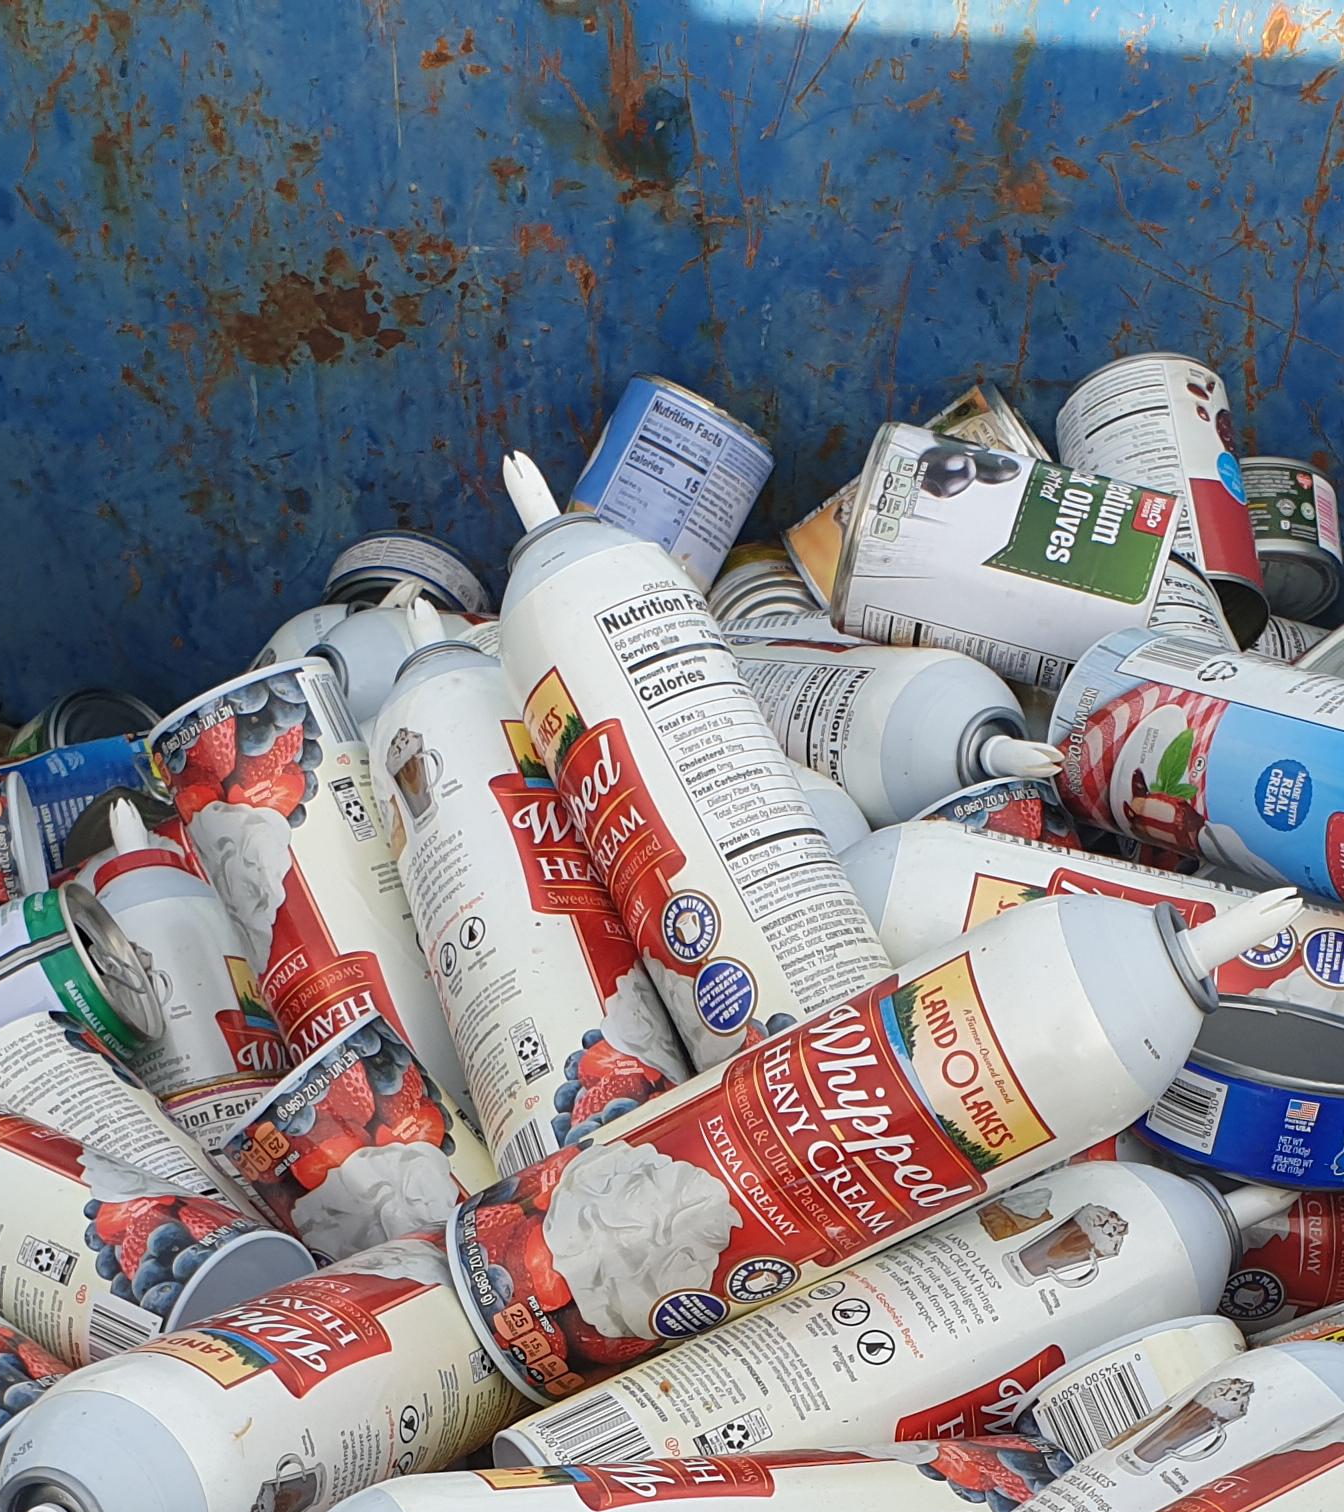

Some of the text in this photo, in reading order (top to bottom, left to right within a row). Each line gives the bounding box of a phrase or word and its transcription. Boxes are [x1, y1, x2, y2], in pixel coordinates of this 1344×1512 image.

[653, 402, 723, 447] Nutrition Facts
[629, 450, 664, 475] Calories
[685, 477, 700, 494] 15
[1045, 488, 1093, 563] Olives
[602, 598, 685, 634] Nutrition
[614, 628, 663, 651] 66 servings
[621, 634, 679, 662] Serving size
[639, 670, 705, 701] Calories
[1264, 768, 1283, 817] CREAM
[1276, 778, 1294, 813] REAL
[1288, 772, 1306, 825] MADE WITH
[274, 954, 309, 987] EXTRA
[299, 963, 364, 1008] Sweetened
[299, 991, 379, 1050] HEAVY
[919, 985, 958, 1049] LAND
[960, 1087, 1014, 1149] LAKES
[966, 1016, 1014, 1105] Farmer-Owned Brand
[808, 1005, 972, 1207] Whipped
[764, 1038, 893, 1235] HEAVY CREAM
[706, 1116, 800, 1237] EXTRA CREAMY
